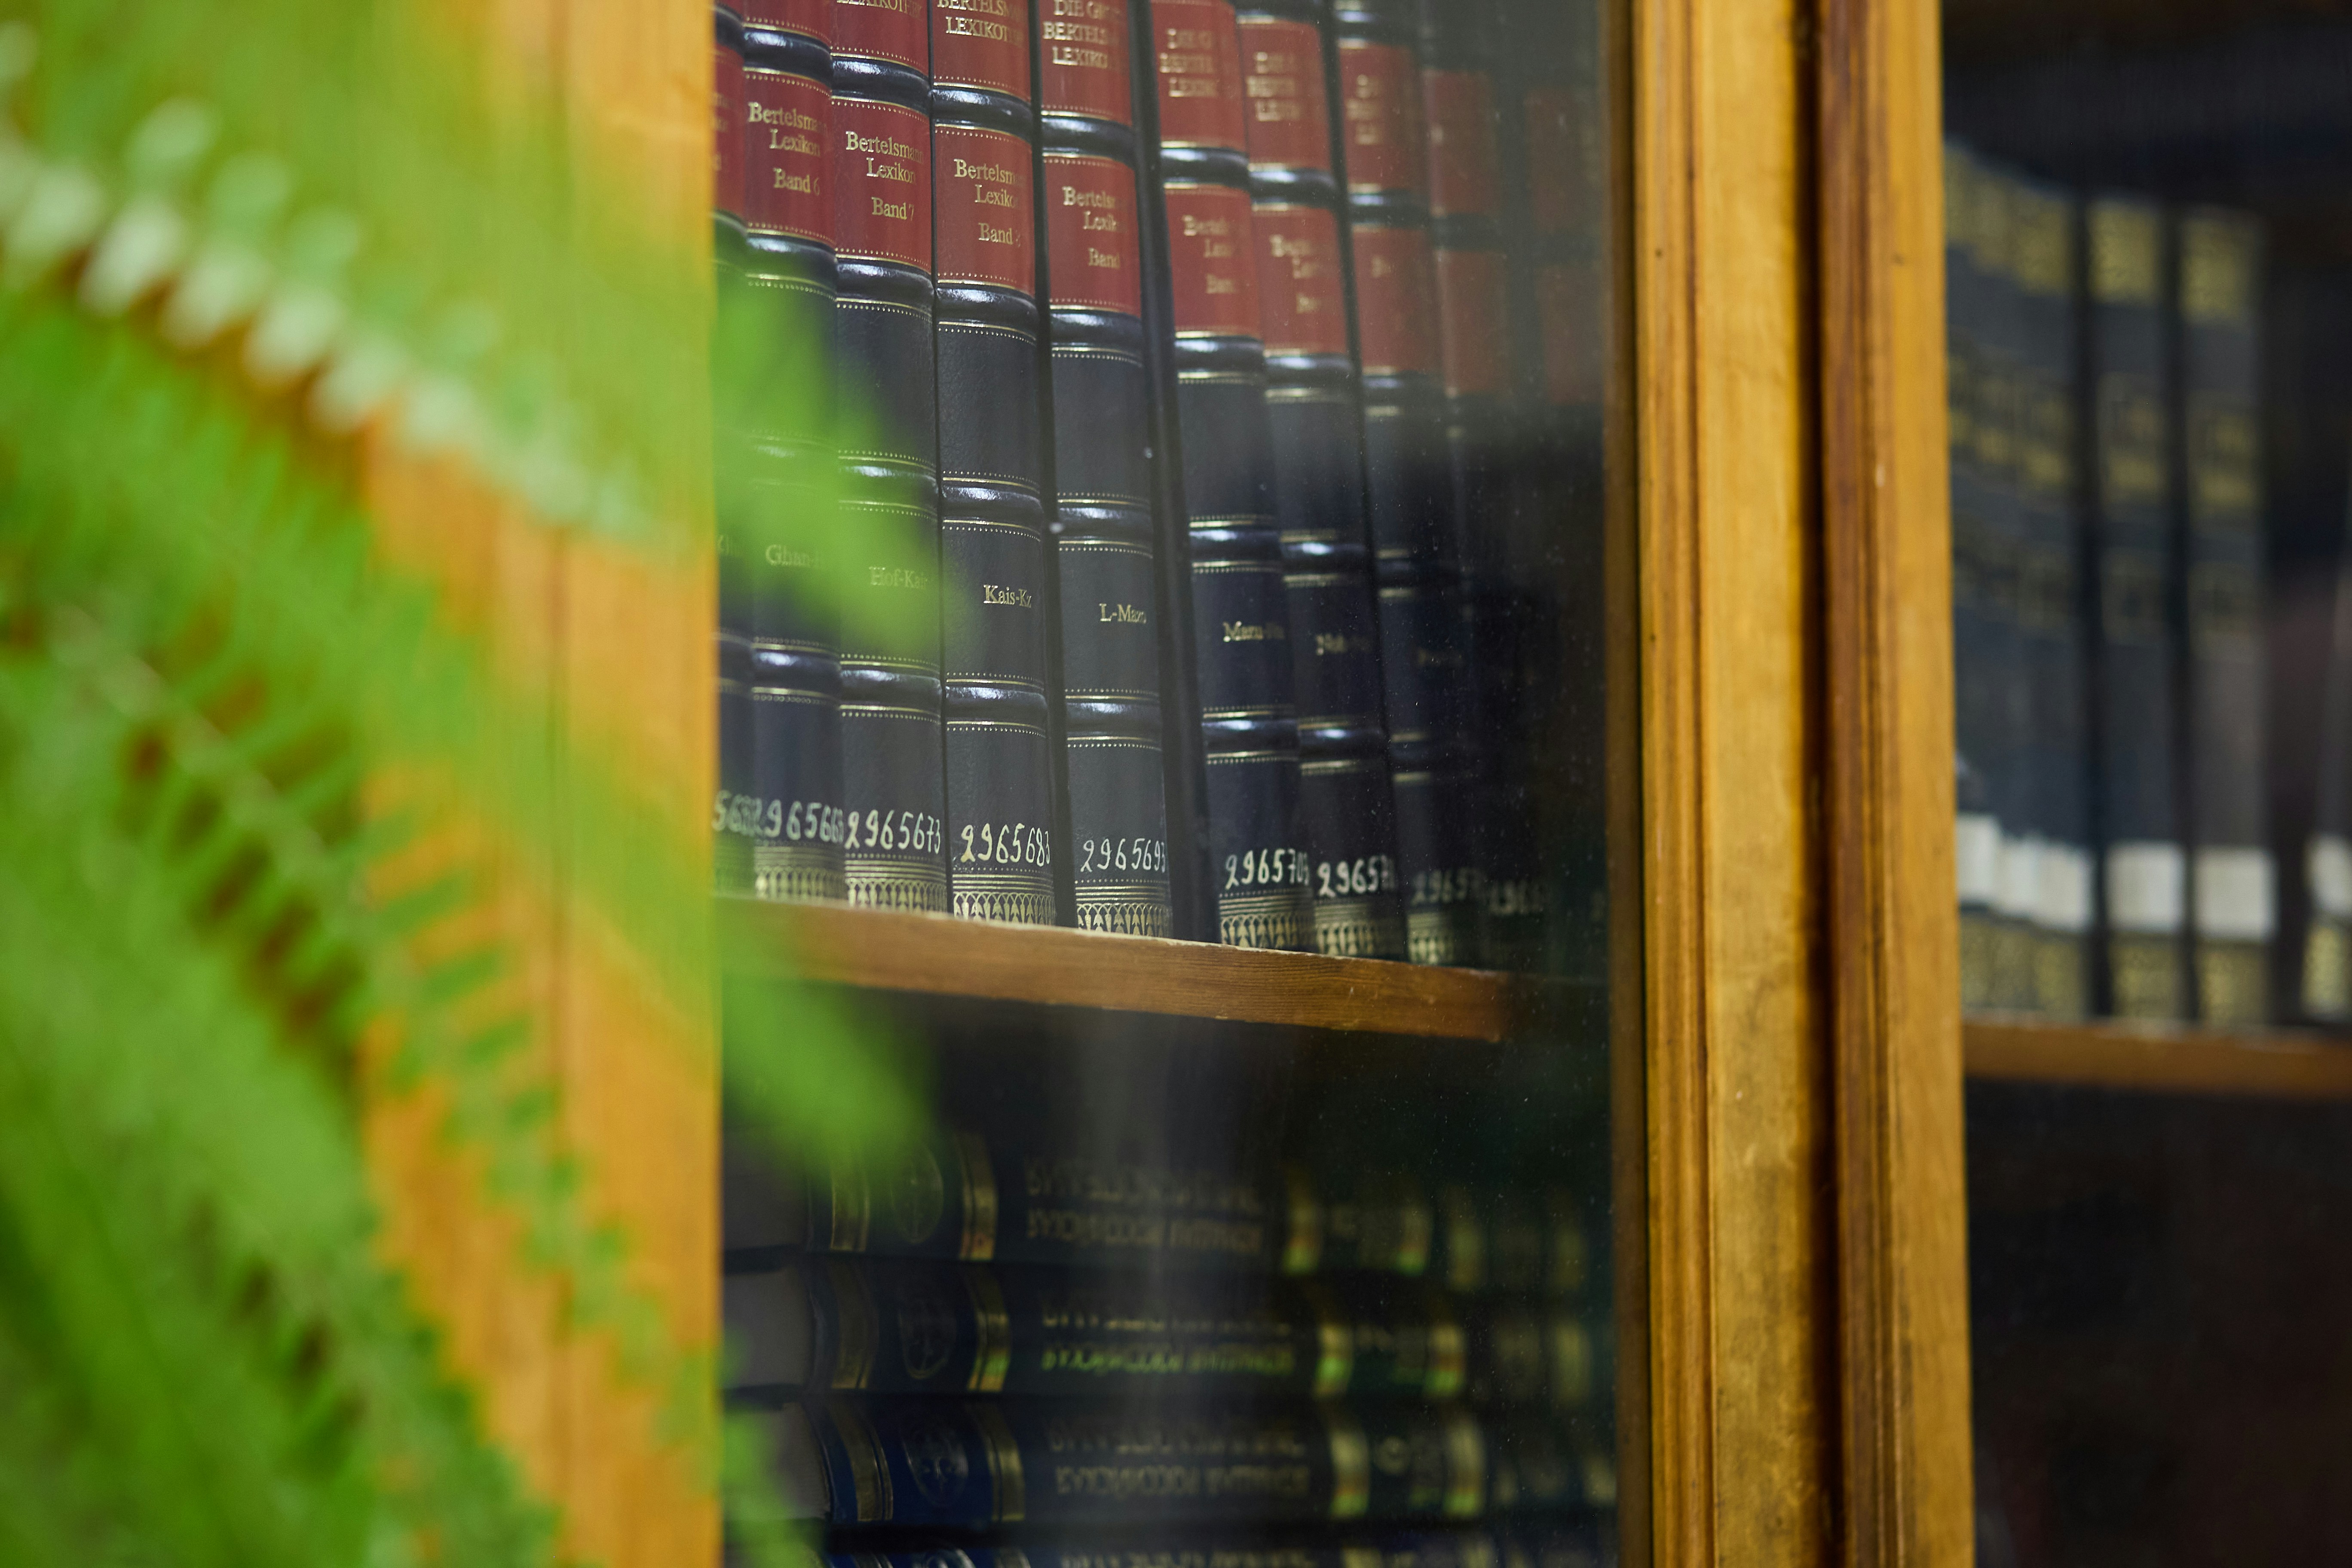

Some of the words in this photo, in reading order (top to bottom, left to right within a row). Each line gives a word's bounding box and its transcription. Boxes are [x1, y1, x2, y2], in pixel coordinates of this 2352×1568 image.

[946, 16, 1020, 46] LEXIKOT
[748, 101, 826, 134] Bertelsm
[845, 131, 924, 165] Bertelsmann
[773, 167, 811, 193] Band
[866, 157, 916, 185] Lexikon
[953, 158, 1019, 186] Bertelsm
[871, 196, 907, 220] Band
[909, 203, 915, 221] 7
[975, 184, 1020, 209] Lexiko
[978, 222, 1014, 245] Band
[983, 584, 1032, 608] Kais-Kz
[844, 809, 941, 854] 2965673
[960, 823, 1050, 867] 2965683
[1080, 838, 1166, 873] 2965693
